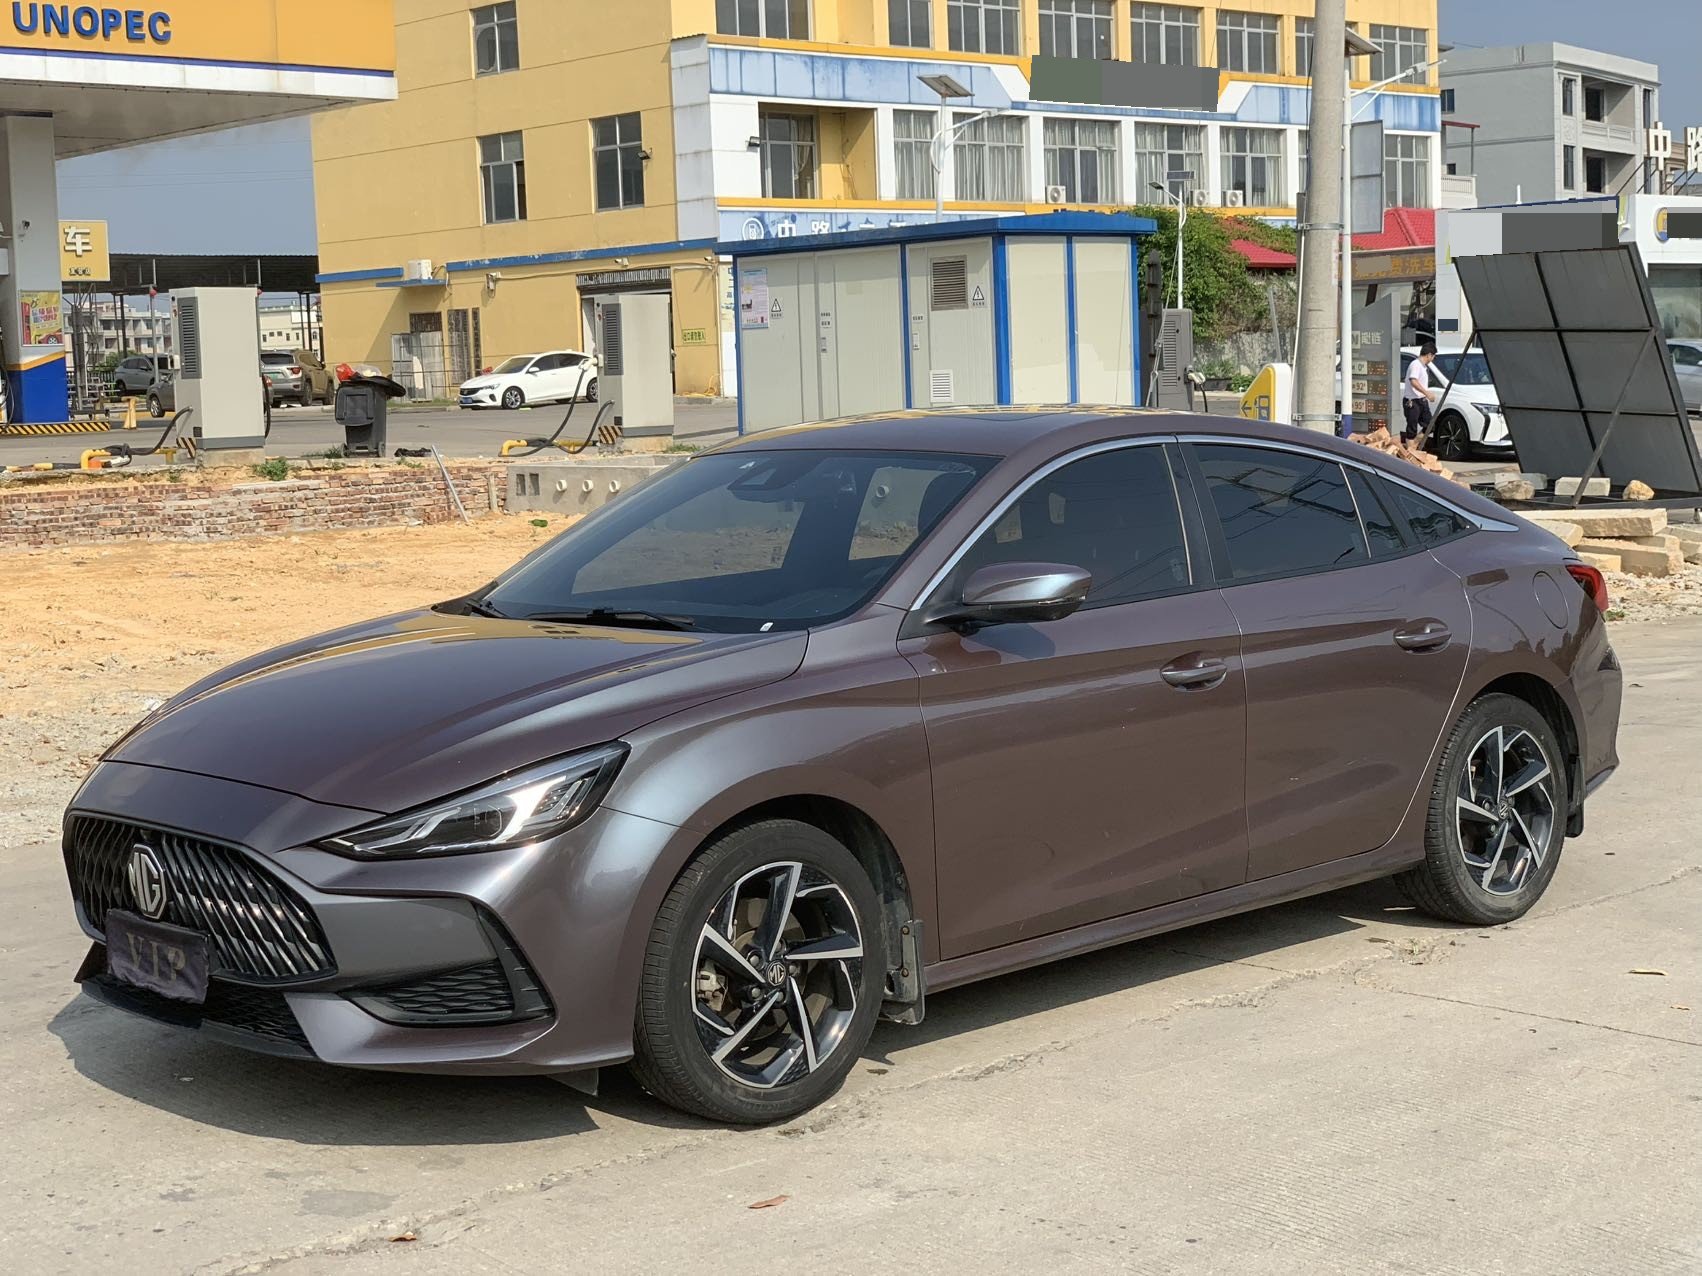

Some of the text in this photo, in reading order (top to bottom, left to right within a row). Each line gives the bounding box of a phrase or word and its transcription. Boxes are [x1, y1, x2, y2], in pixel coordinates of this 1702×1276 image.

[12, 1, 172, 42] UNOPEC
[64, 226, 93, 257] 车
[128, 849, 164, 915] MG
[127, 933, 186, 983] VIP
[769, 963, 785, 985] MG
